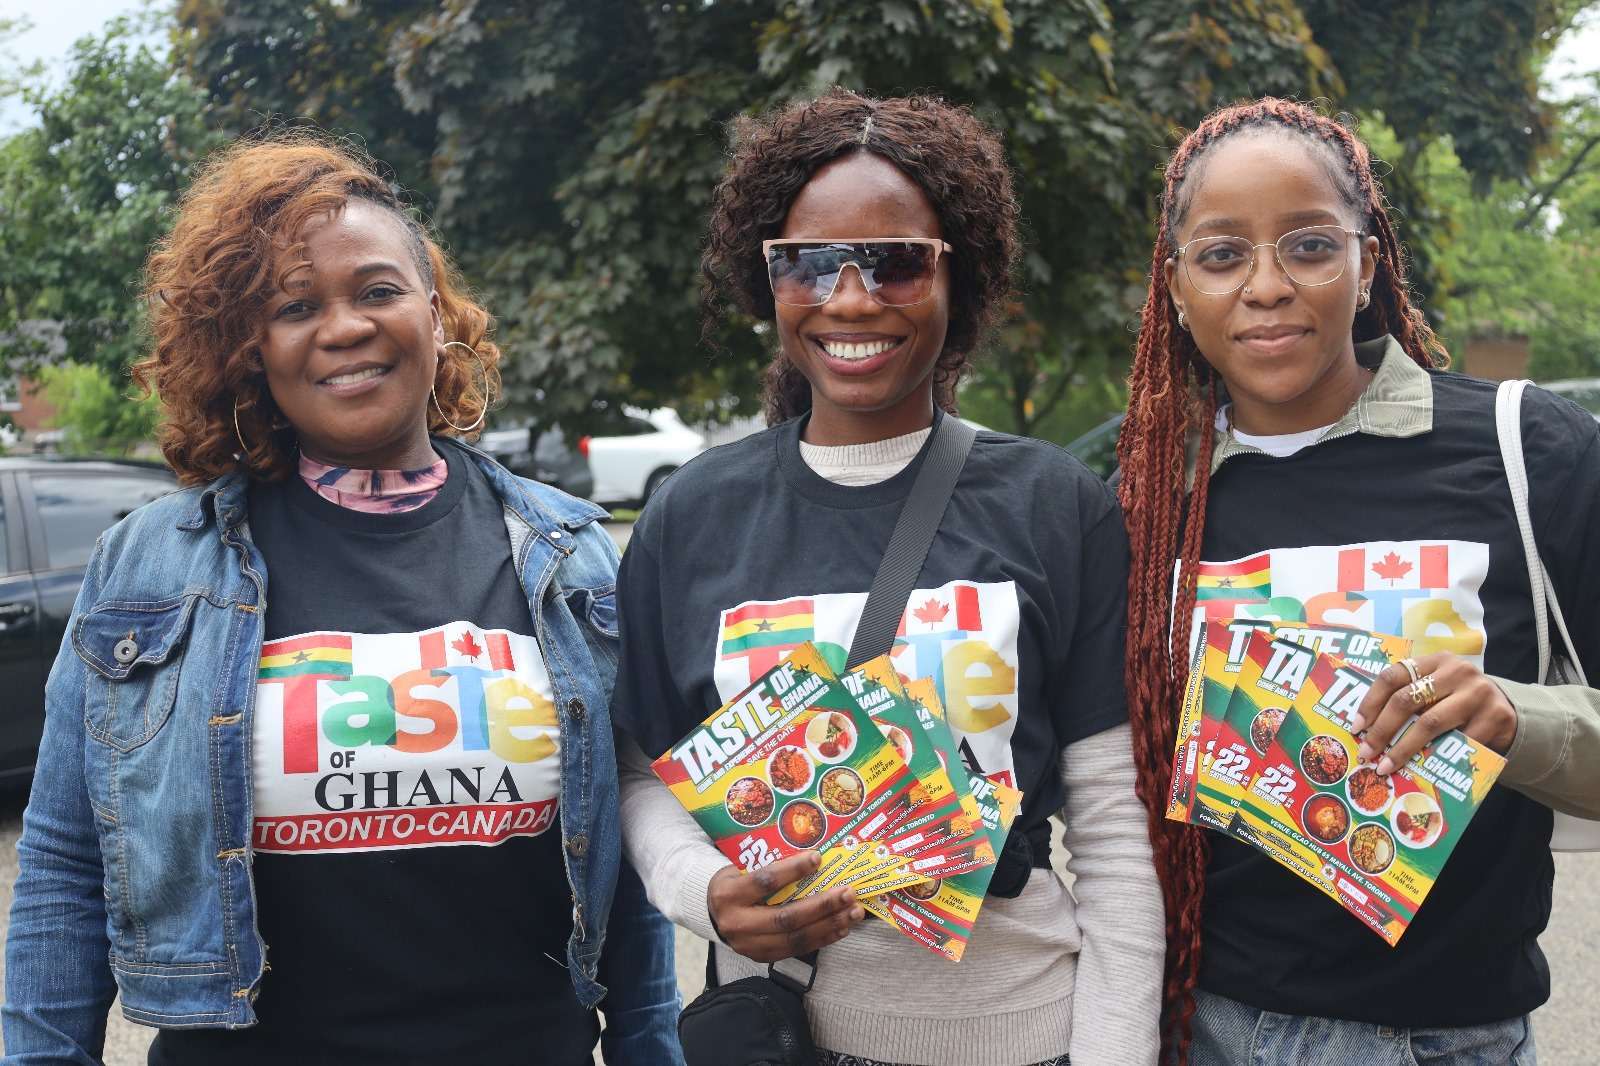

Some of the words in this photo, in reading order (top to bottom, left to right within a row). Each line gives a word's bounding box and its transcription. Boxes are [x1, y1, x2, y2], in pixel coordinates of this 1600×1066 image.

[780, 672, 824, 712] GHANA
[856, 686, 892, 711] HANA
[671, 682, 782, 786] TASTE
[769, 661, 796, 696] OF
[329, 750, 356, 769] OF
[746, 747, 765, 765] SAVE
[763, 737, 778, 752] THE
[775, 724, 795, 742] DATE
[1435, 735, 1476, 764] OF
[870, 760, 884, 772] TIME
[1210, 747, 1251, 780] 22
[1277, 763, 1296, 777] JUNE
[1422, 754, 1474, 794] GHANA
[314, 763, 525, 812] GHANA
[1255, 766, 1297, 804] 22
[253, 802, 553, 845] TORONTO-CANADA
[818, 840, 832, 852] HUB
[836, 818, 858, 837] MAYALL
[867, 788, 893, 812] TORONTO
[906, 813, 934, 830] TORONTO
[1235, 827, 1248, 838] FOR
[738, 838, 769, 874] 22
[1270, 819, 1292, 836] VENUE:
[1291, 832, 1309, 847] GCAO
[1308, 841, 1323, 856] HUB
[1321, 848, 1331, 860] 65
[1329, 856, 1353, 877] MAYALL
[1364, 880, 1392, 904] TORONTO
[1400, 871, 1414, 884] TIME
[915, 905, 944, 925] TORONTO
